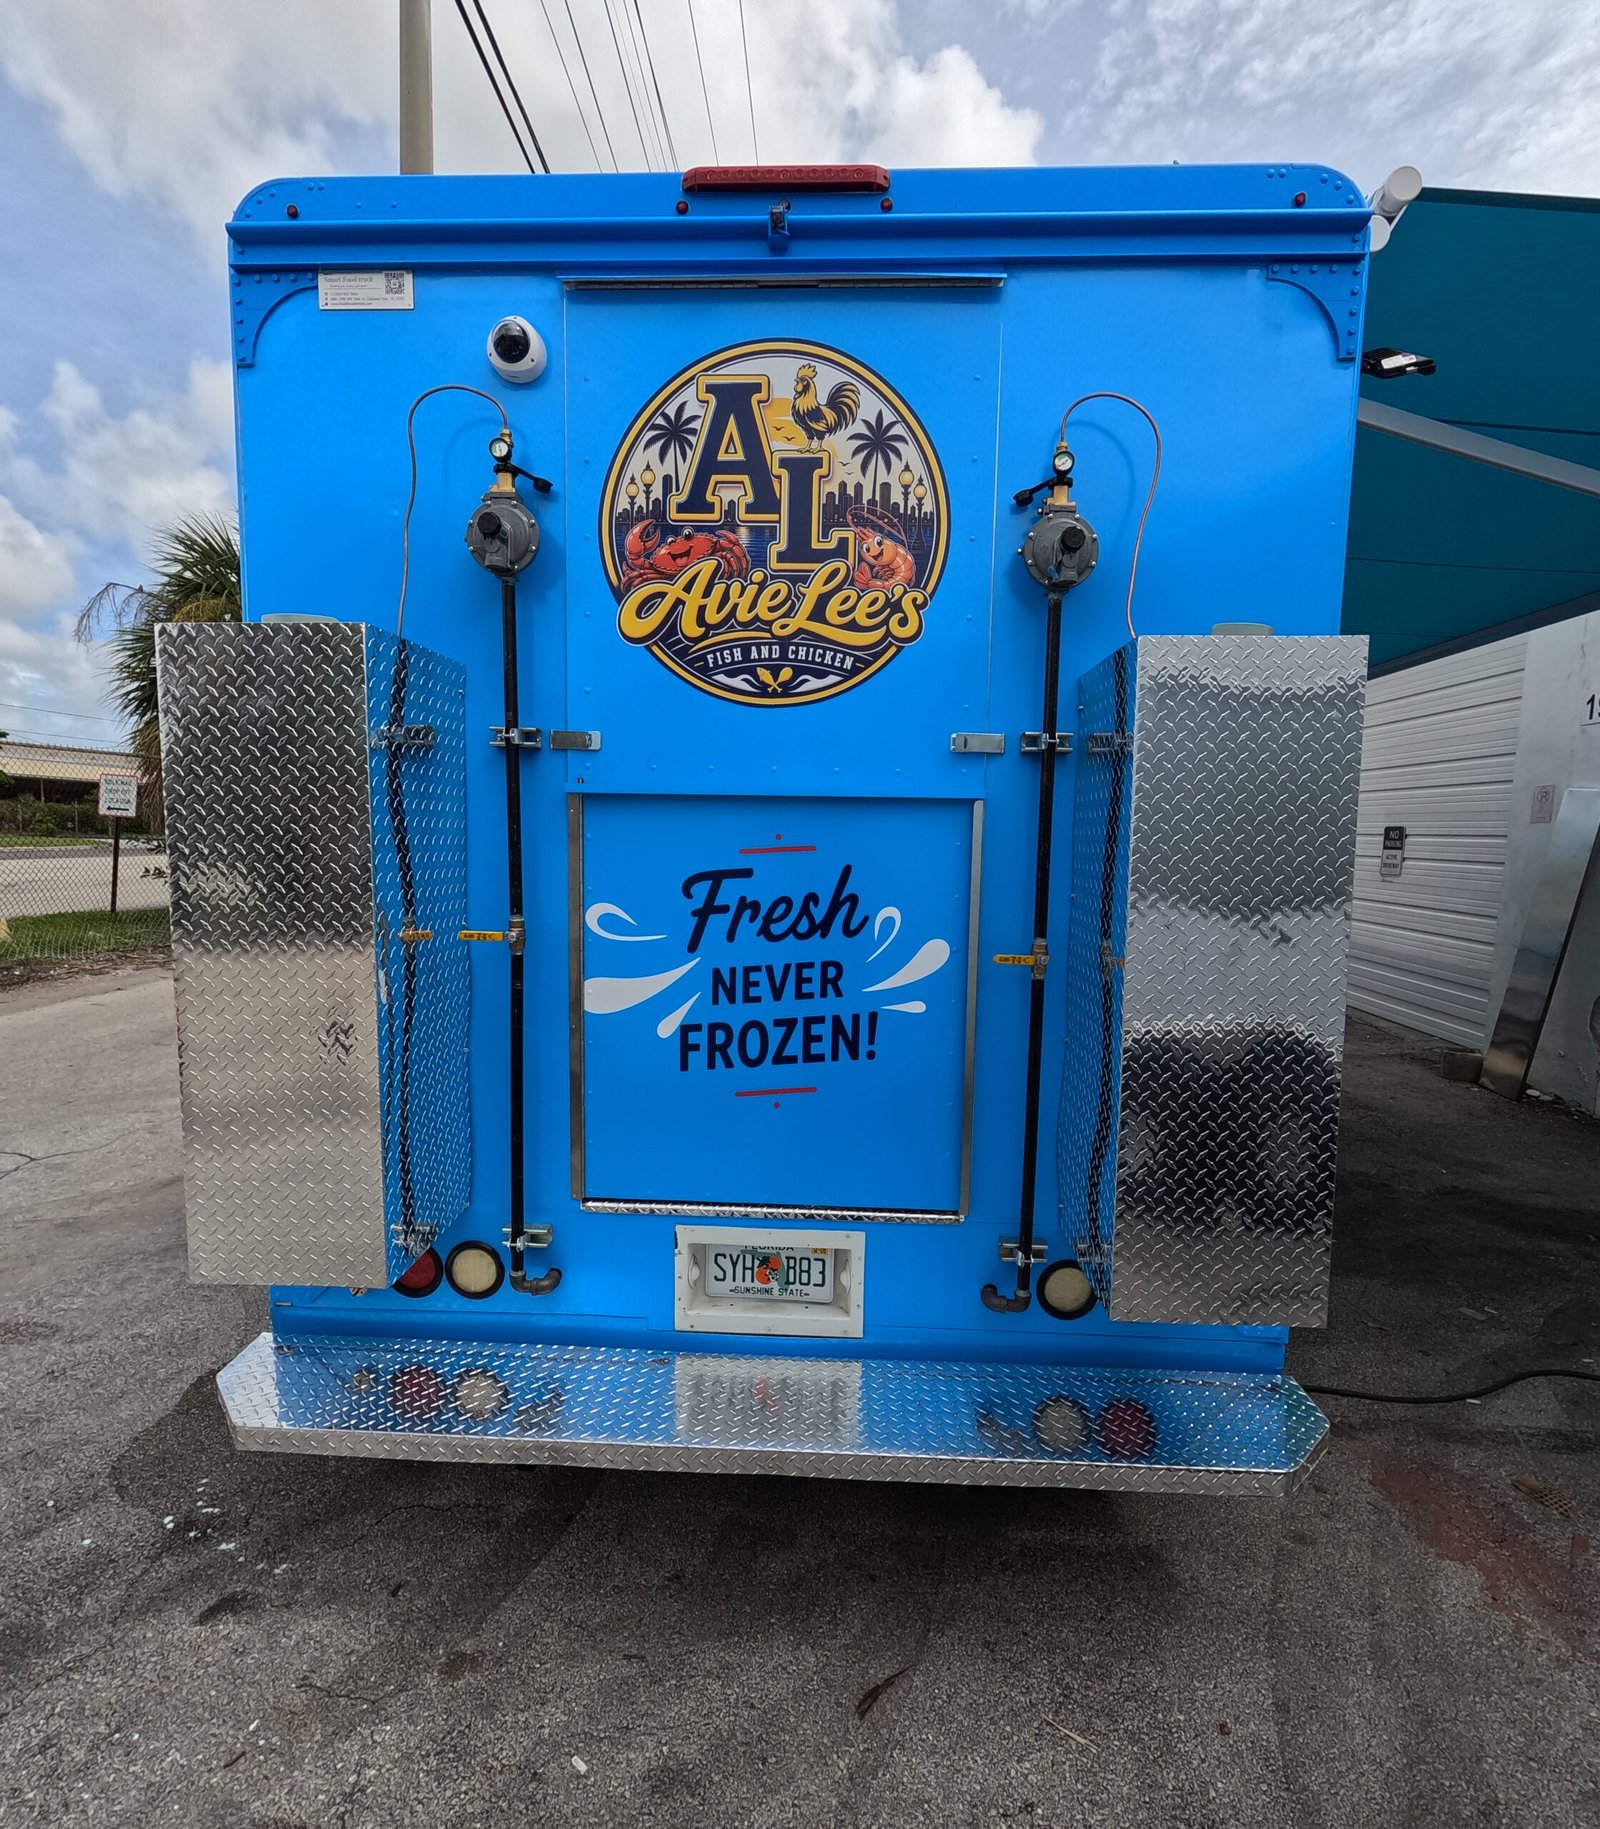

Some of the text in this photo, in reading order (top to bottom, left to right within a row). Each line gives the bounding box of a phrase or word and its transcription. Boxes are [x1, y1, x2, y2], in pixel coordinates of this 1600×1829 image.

[706, 645, 854, 670] FISH AND CHICKEN
[1586, 693, 1600, 720] 1
[1389, 830, 1400, 839] NO
[681, 864, 869, 954] Fresh
[711, 960, 844, 1006] NEVER
[679, 1011, 878, 1072] FROZEN!
[714, 1253, 826, 1288] SYH B83
[735, 1286, 804, 1297] SUNSHINE STATE
